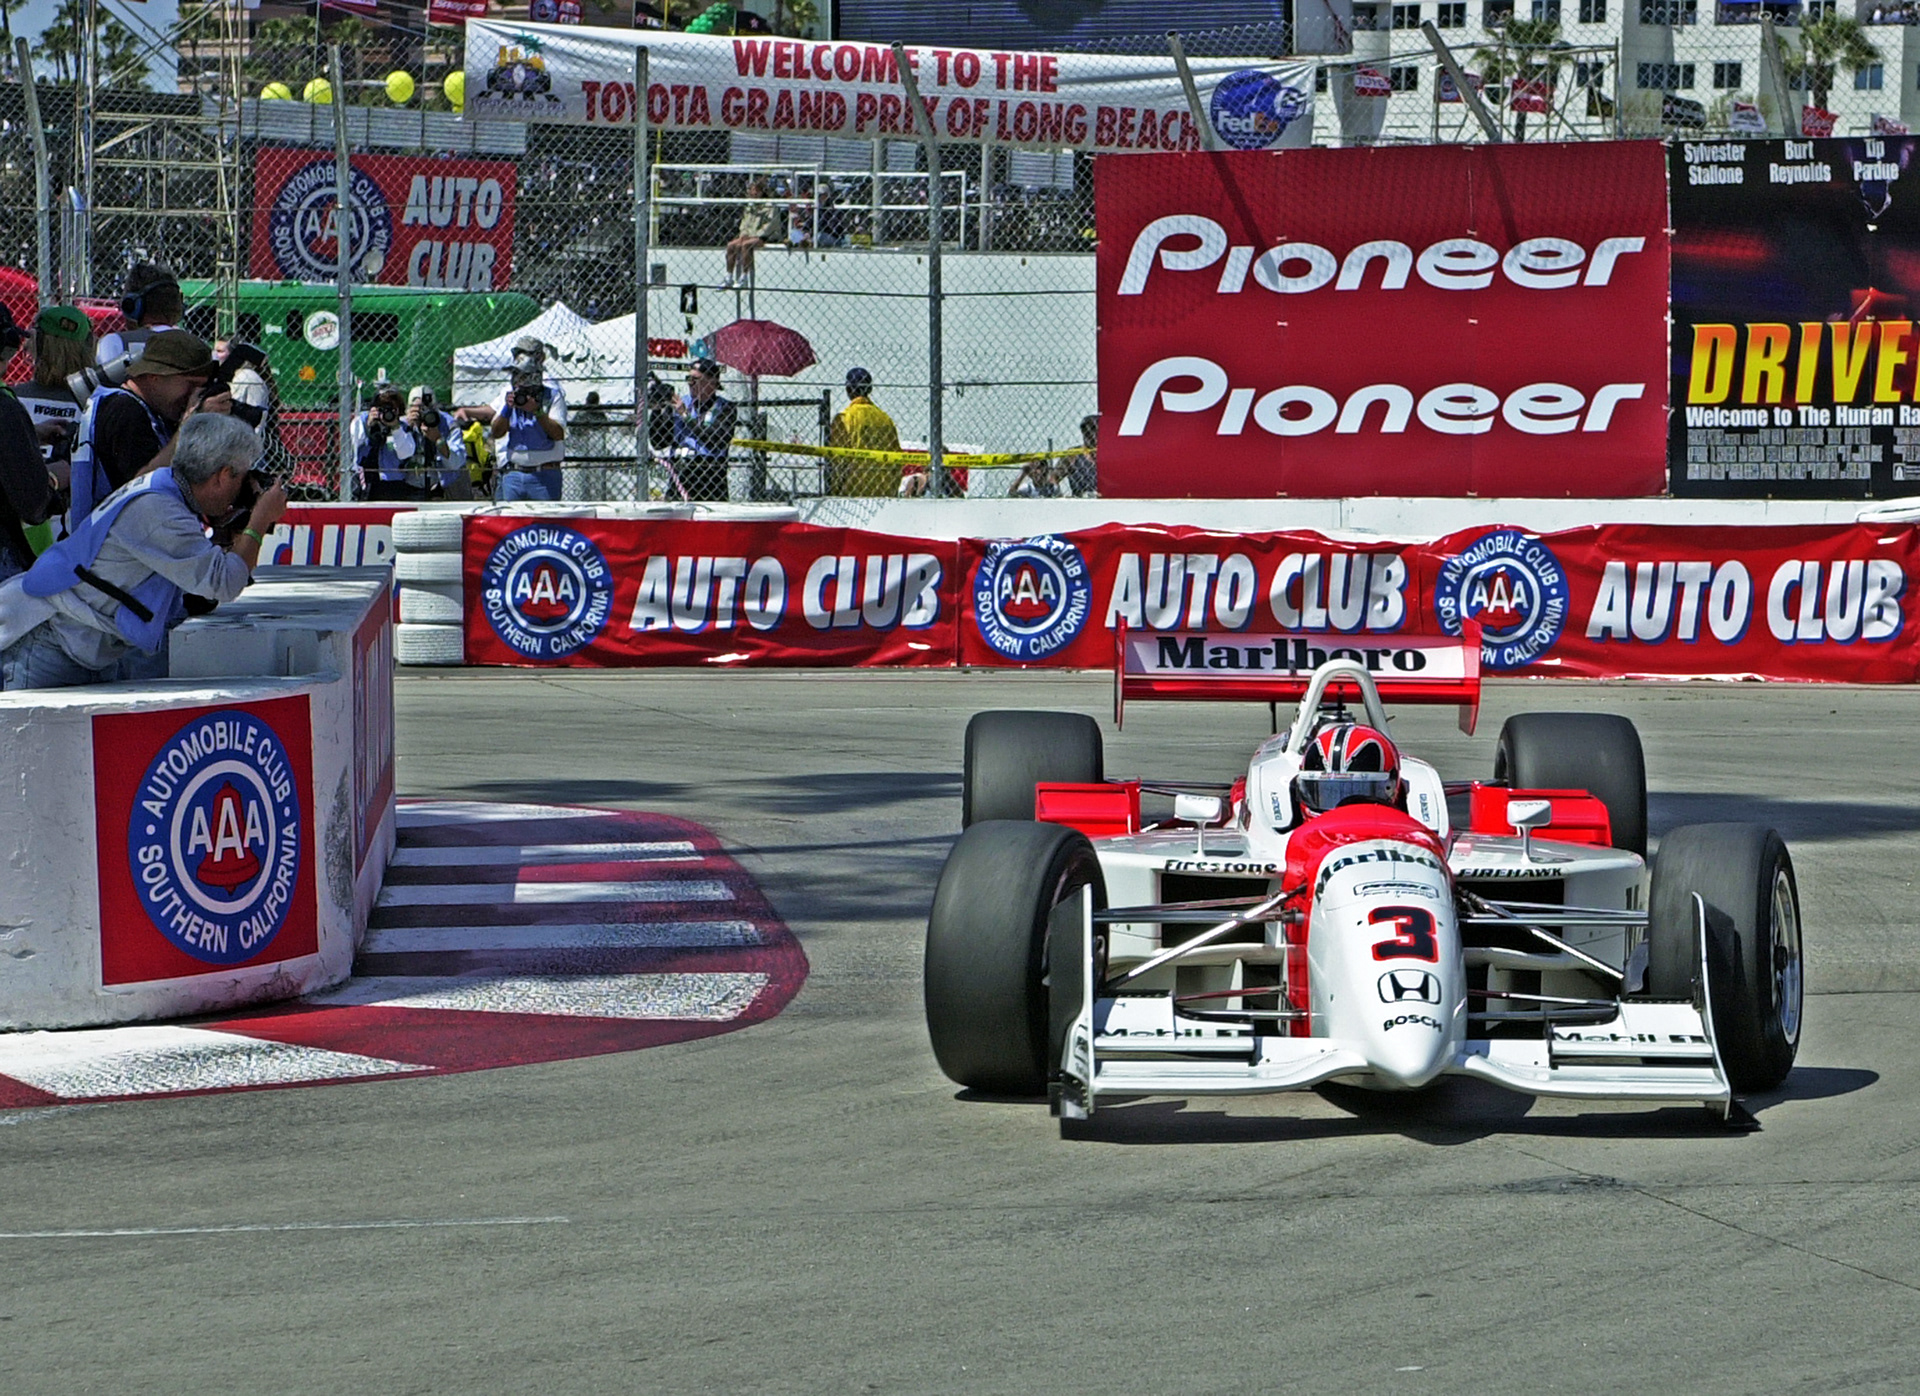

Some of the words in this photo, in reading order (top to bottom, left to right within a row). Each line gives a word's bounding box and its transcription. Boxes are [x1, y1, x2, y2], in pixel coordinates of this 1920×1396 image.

[733, 40, 918, 84] WELCOME
[932, 50, 981, 88] TO
[991, 53, 1058, 92] THE
[721, 86, 848, 131] GRAND
[855, 92, 938, 136] PRIX
[946, 96, 990, 138] OF
[996, 100, 1088, 145] LONG
[1096, 106, 1200, 152] BEACH
[1684, 143, 1746, 164] Sylvester
[1689, 164, 1744, 186] Stallone
[1769, 162, 1832, 184] Reynolds
[1785, 140, 1815, 160] Burt
[1853, 162, 1900, 181] Pardue
[402, 174, 502, 230] AUTO
[407, 239, 496, 291] CLUB
[1116, 214, 1647, 295] Pioneer
[1687, 320, 1920, 405] DRIVE
[1117, 356, 1647, 436] Pioneer
[1685, 406, 1768, 426] Welcome
[1774, 407, 1793, 426] to
[1798, 406, 1830, 426] The
[489, 529, 575, 577] AUTOMOBILE
[571, 541, 604, 579] CLUB
[1443, 534, 1528, 584] AUTOMOBILE
[1526, 547, 1560, 586] CLUB
[515, 569, 576, 605] AAA
[629, 555, 786, 631] AUTO
[802, 553, 943, 629] CLUB
[1001, 570, 1056, 605] AAA
[1105, 553, 1257, 630] AUTO
[1269, 553, 1408, 631] CLUB
[1470, 577, 1529, 614] AAA
[1586, 560, 1752, 642] AUTO
[1768, 559, 1905, 641] CLUB
[486, 588, 542, 654] SOUTHERN
[550, 589, 609, 653] CALIFORNIA
[978, 591, 1023, 655] SOUTHERN
[1029, 588, 1088, 655] CALIFORNIA
[1504, 597, 1564, 665] CALIFORNIA
[142, 721, 258, 819] AUTOMOBILE
[257, 738, 291, 803] CLUB
[187, 797, 265, 863] AAA
[138, 844, 229, 954] SOUTHERN
[238, 821, 298, 950] CALIFORNIA
[1456, 866, 1562, 879] FIREHAWK
[1368, 905, 1442, 962] 3
[1383, 1014, 1443, 1032] BOSCH
